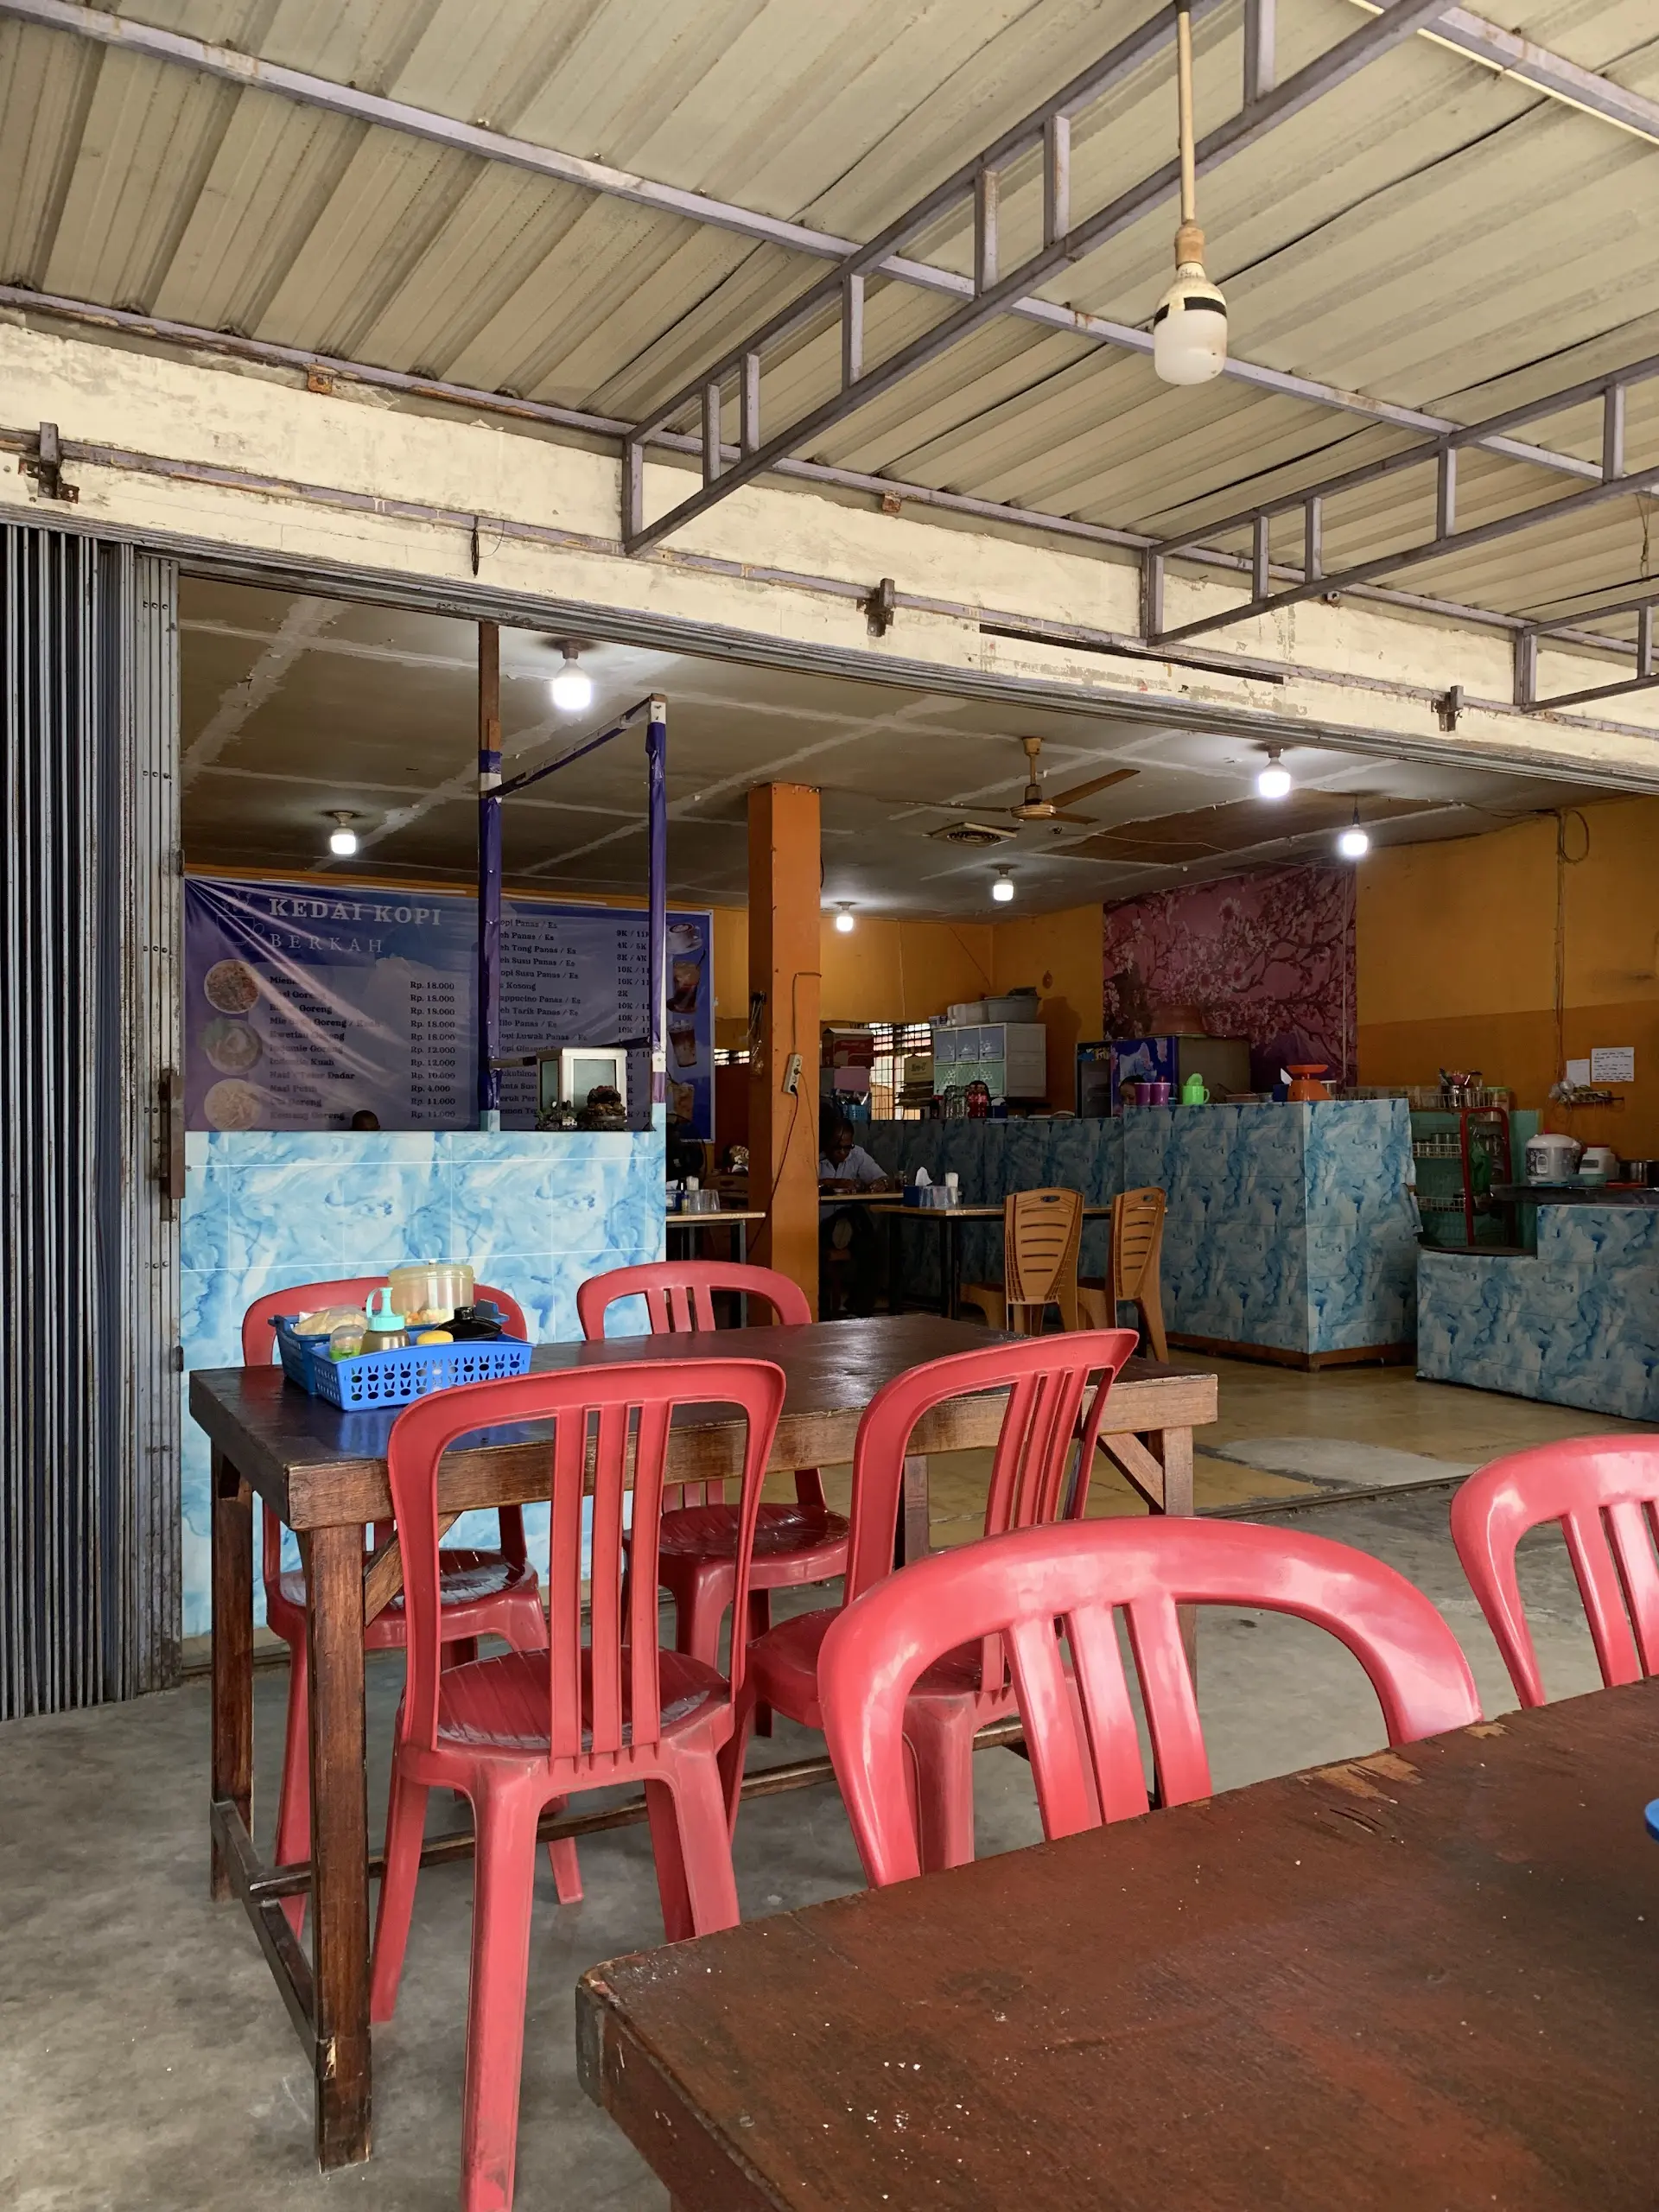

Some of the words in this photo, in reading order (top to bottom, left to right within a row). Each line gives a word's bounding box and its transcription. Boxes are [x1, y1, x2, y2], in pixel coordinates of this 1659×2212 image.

[270, 898, 363, 922] KEDAI
[373, 906, 442, 926] KOPI
[515, 919, 539, 928] Panas
[512, 931, 536, 940] Panas
[270, 933, 383, 953] BERKAH
[511, 944, 532, 954] Tong
[534, 945, 558, 954] Panas
[512, 957, 531, 965] Susu
[533, 957, 557, 966] Panas
[410, 981, 423, 990] Rp.
[506, 982, 536, 992] Kosong
[410, 994, 423, 1002] Rp.
[499, 995, 537, 1004] appucino
[299, 1005, 333, 1014] Goreng
[410, 1007, 423, 1015] Rp.
[512, 1007, 535, 1015] Tarik
[314, 1018, 347, 1029] Goreng
